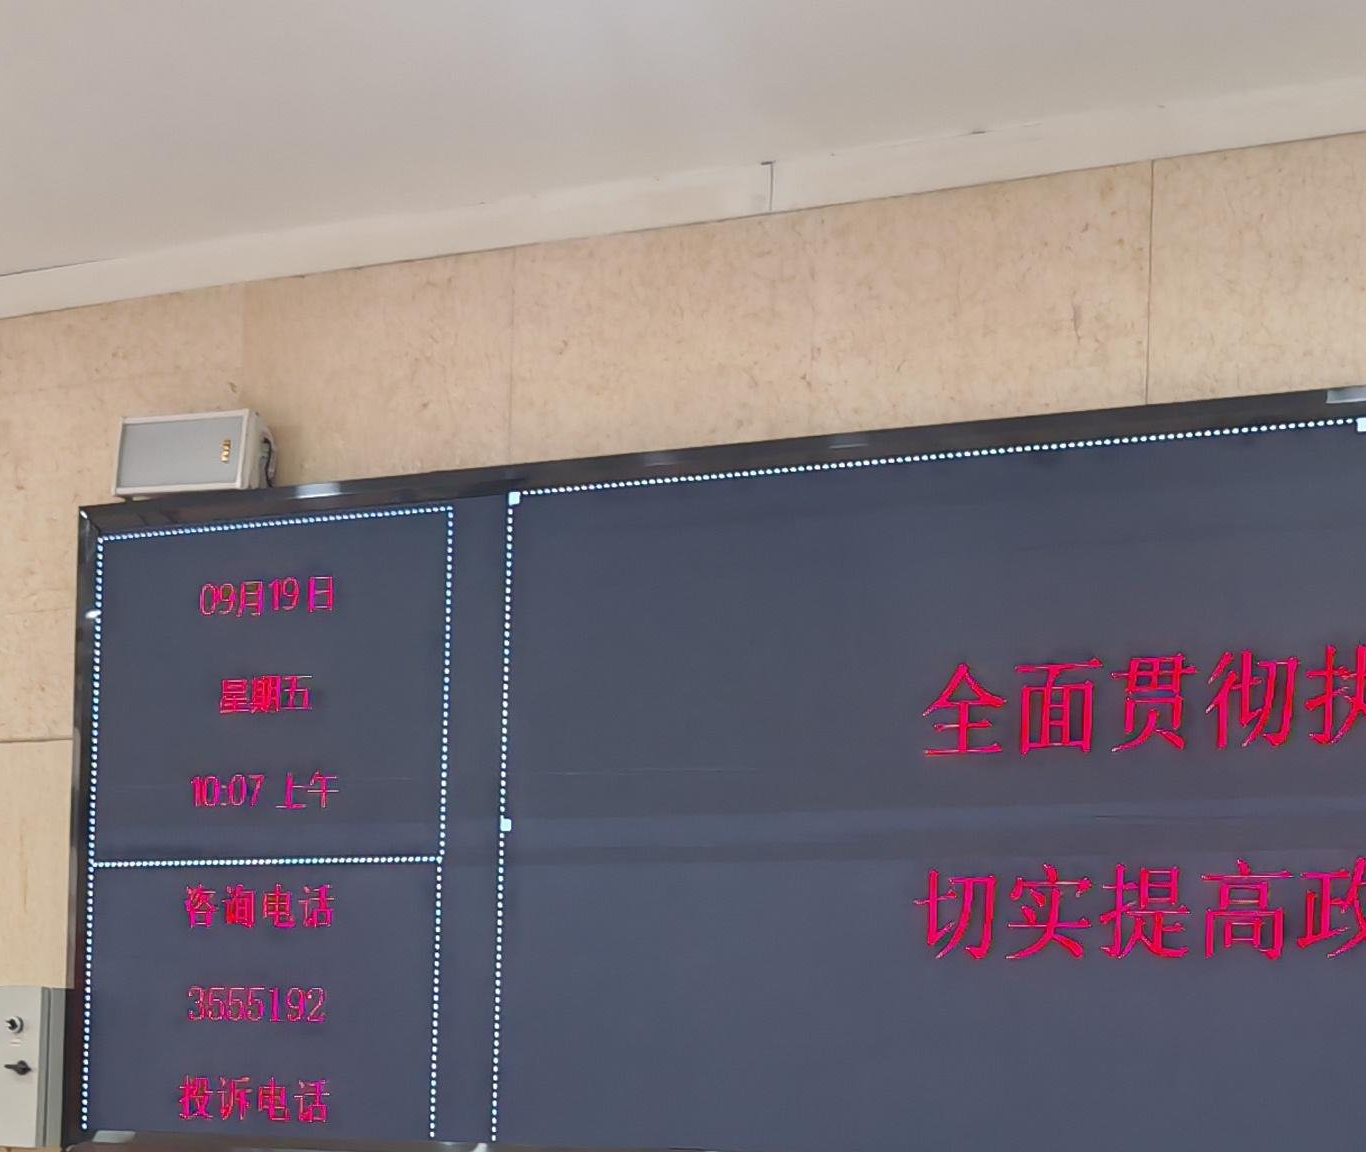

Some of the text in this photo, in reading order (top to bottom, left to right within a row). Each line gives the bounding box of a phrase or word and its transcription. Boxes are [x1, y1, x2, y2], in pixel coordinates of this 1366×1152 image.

[199, 576, 335, 618] 09月19日
[218, 675, 313, 714] 星期五
[190, 772, 338, 810] 10:07 上午
[184, 884, 334, 929] 咨询电话
[187, 985, 327, 1023] 3555192
[178, 1077, 331, 1123] 投诉电话
